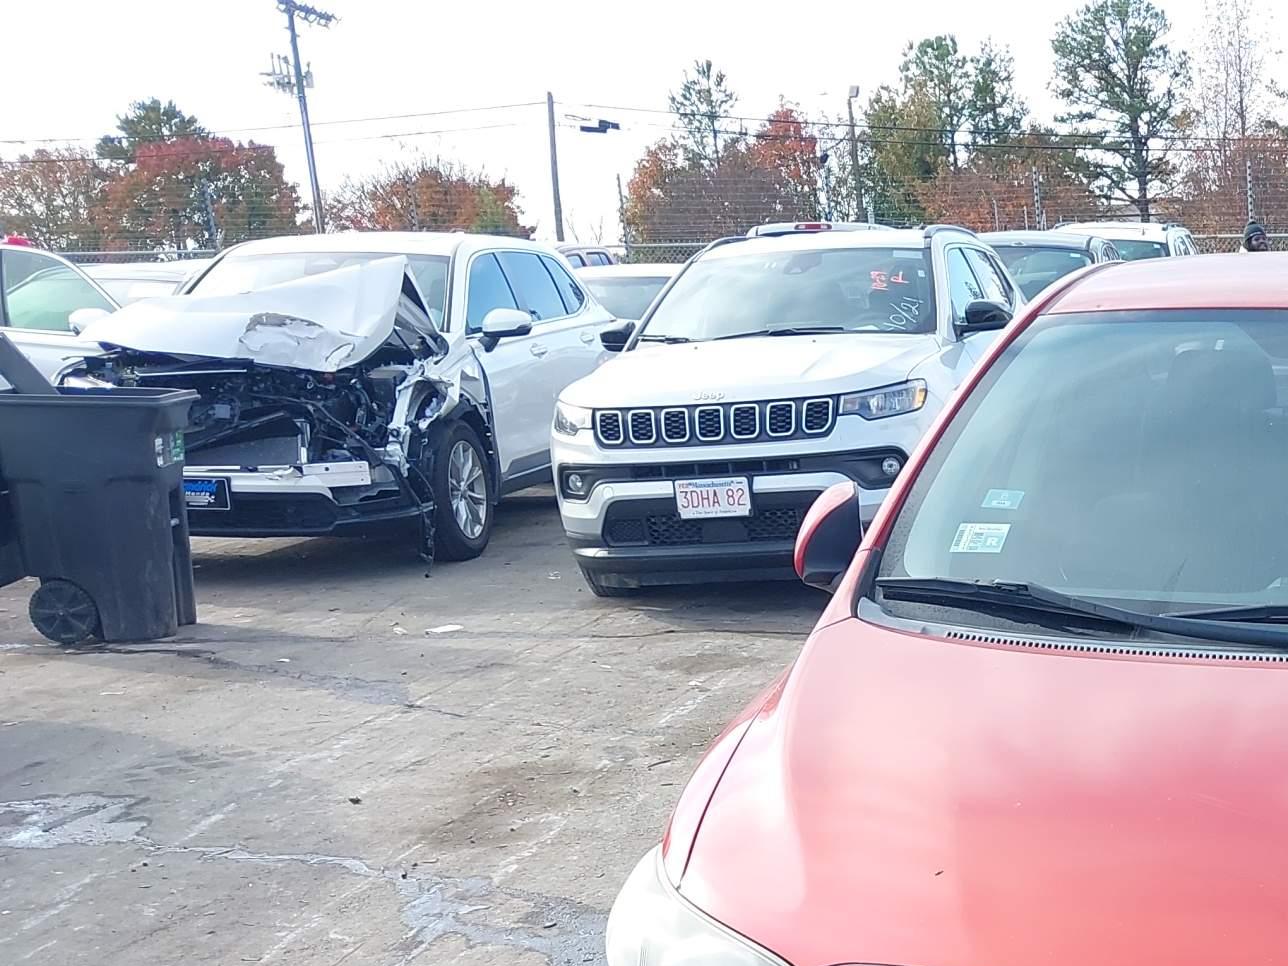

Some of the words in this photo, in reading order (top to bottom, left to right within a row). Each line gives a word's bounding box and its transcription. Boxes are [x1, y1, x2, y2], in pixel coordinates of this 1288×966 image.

[695, 391, 725, 401] Jeep
[679, 489, 721, 509] 3DHA
[725, 487, 747, 506] 82
